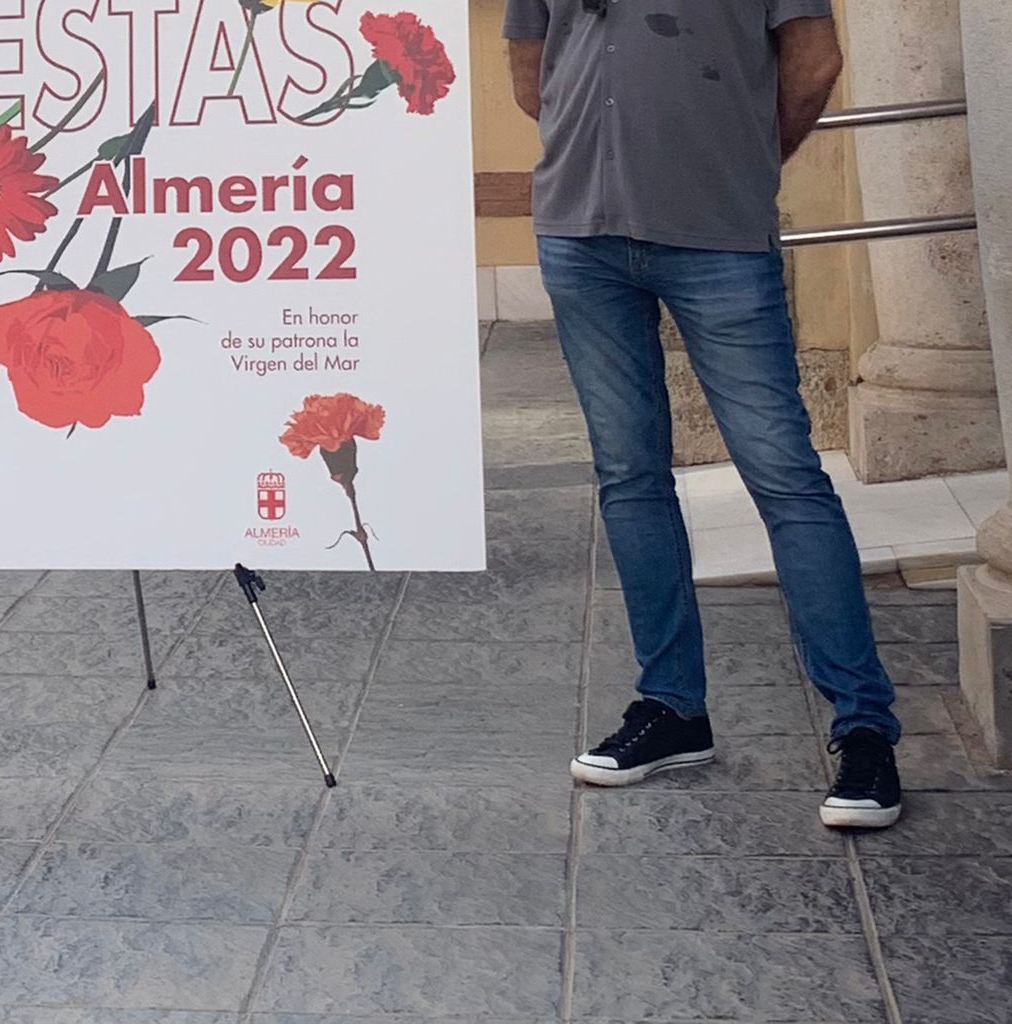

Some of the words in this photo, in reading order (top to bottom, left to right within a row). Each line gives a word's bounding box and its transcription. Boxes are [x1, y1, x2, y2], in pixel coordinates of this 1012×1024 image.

[76, 154, 354, 215] Almería
[172, 224, 357, 283] 2022
[282, 308, 303, 325] En
[309, 306, 359, 325] honor
[221, 330, 242, 349] de
[248, 337, 265, 349] su
[271, 333, 337, 353] patrona
[343, 329, 359, 348] la
[231, 355, 287, 377] Virgen
[293, 352, 318, 371] del
[324, 355, 360, 371] Mar
[244, 525, 300, 538] ALMERÍA
